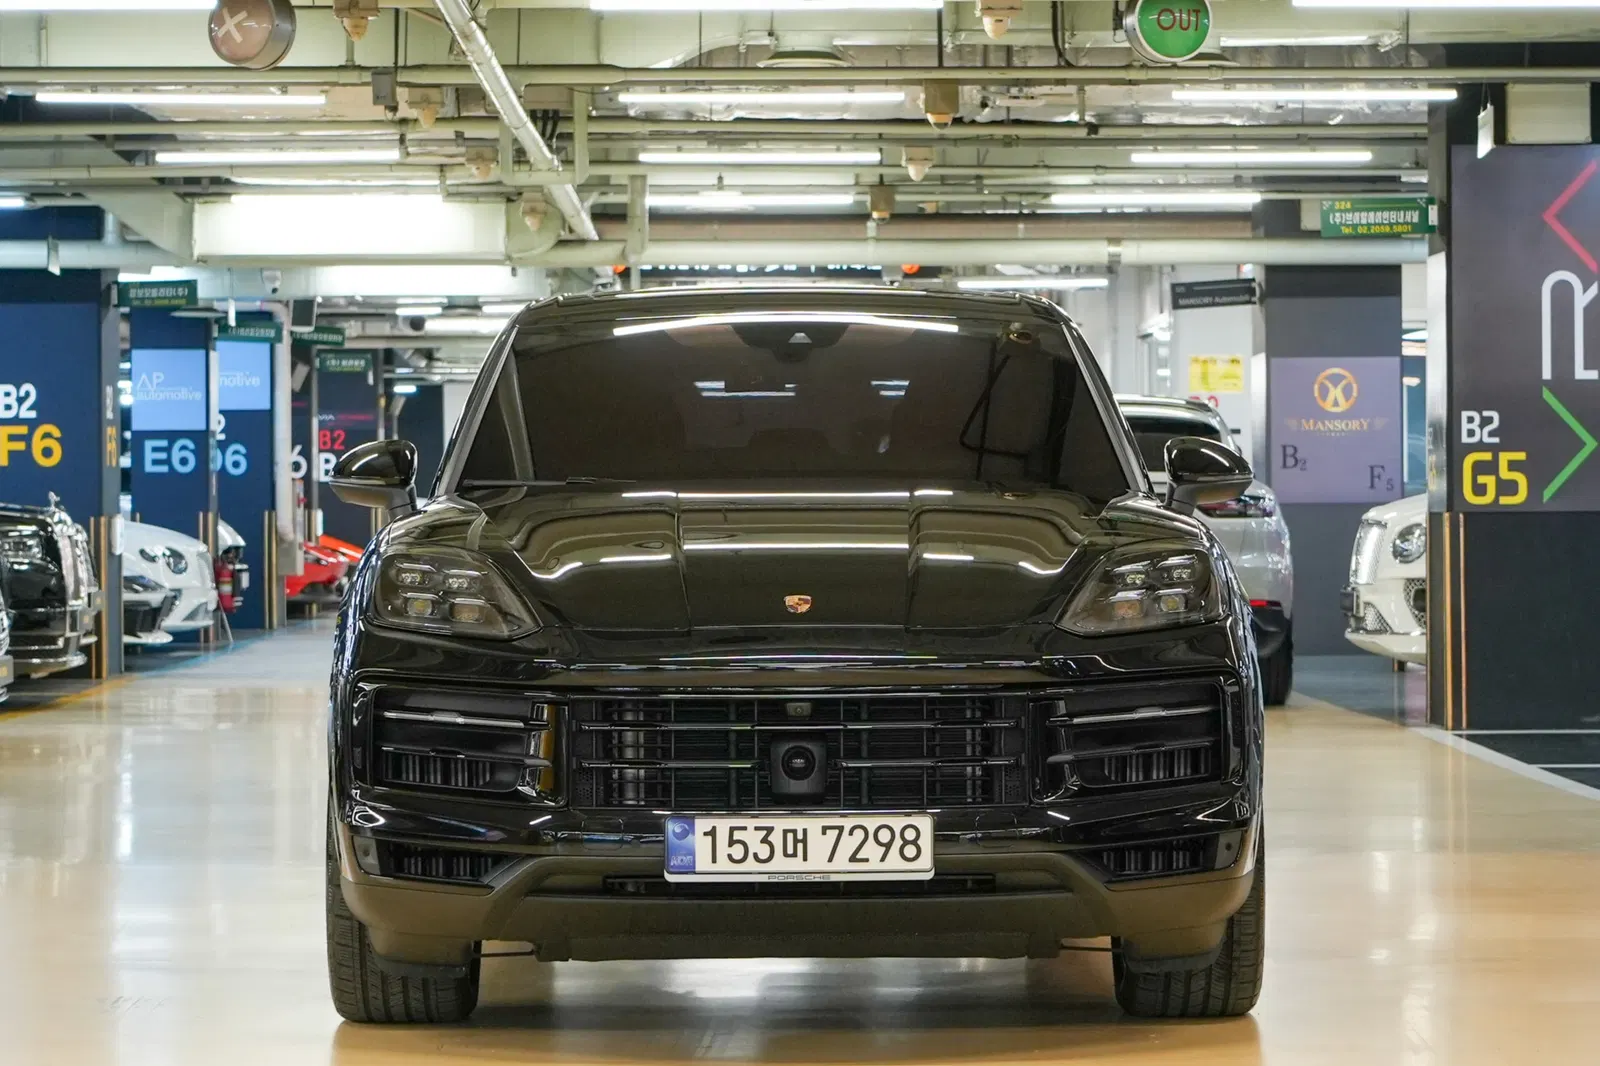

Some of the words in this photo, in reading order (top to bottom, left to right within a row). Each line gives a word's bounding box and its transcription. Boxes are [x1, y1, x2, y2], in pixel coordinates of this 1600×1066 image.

[1157, 8, 1201, 31] OUT
[0, 383, 37, 418] B2
[318, 429, 346, 450] B2
[1301, 418, 1370, 431] MANSORY
[1461, 411, 1500, 443] B2
[0, 424, 62, 467] F6
[144, 438, 196, 474] E6
[1462, 451, 1529, 505] G5
[703, 825, 808, 864] 153머
[821, 823, 922, 863] 7298
